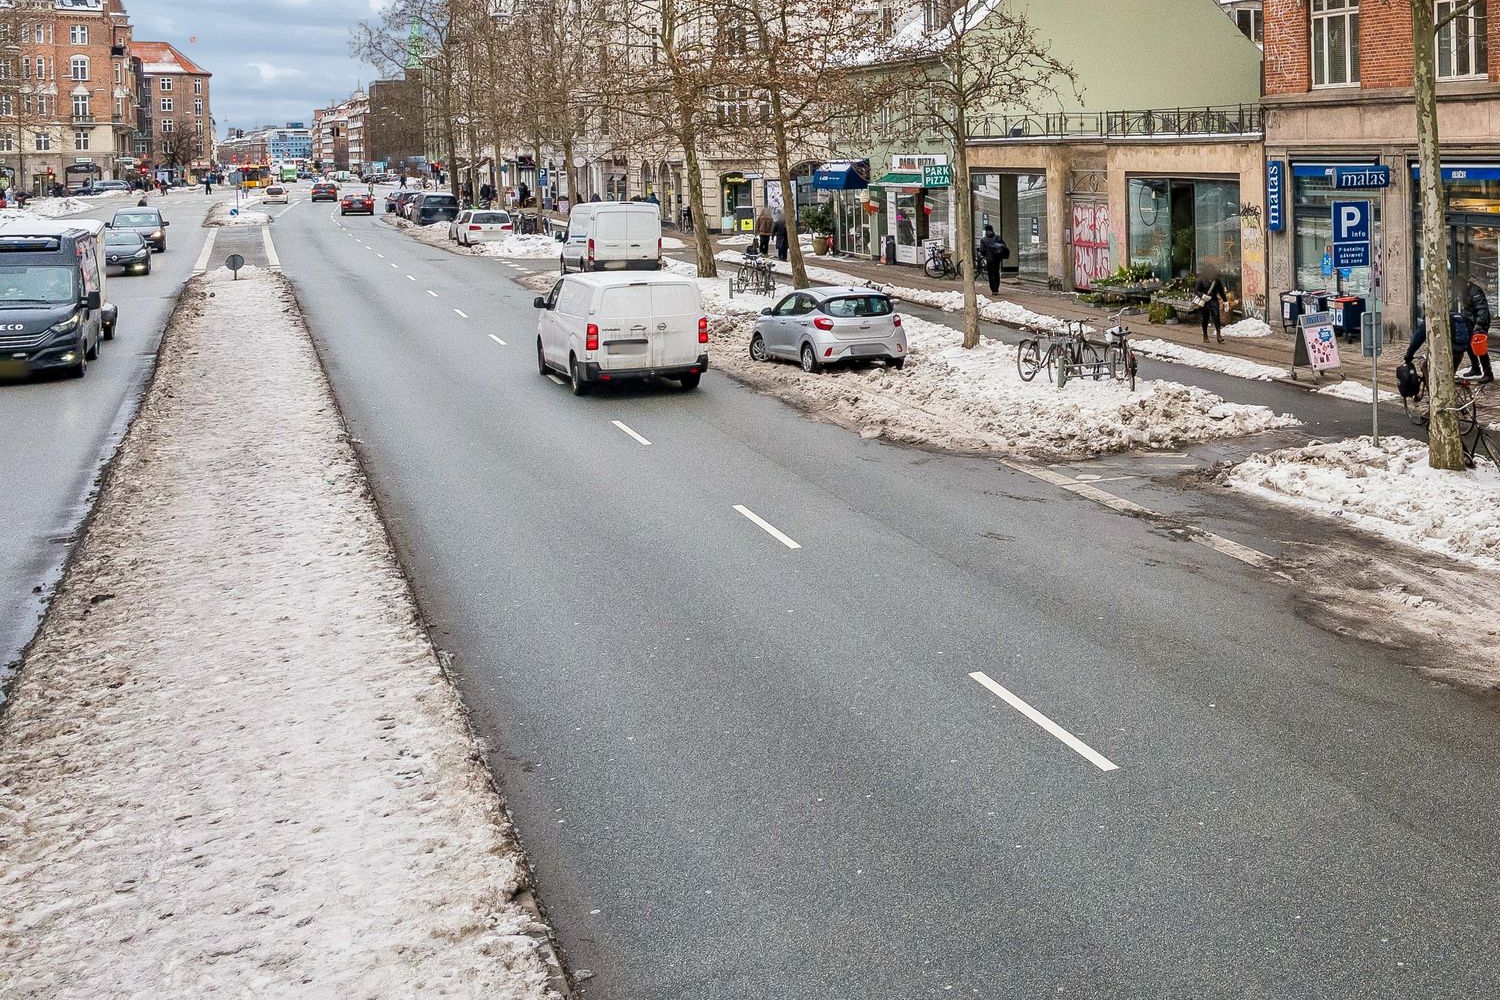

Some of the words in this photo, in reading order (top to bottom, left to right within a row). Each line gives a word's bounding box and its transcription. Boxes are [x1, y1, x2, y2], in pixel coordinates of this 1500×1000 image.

[539, 169, 546, 178] P
[925, 166, 949, 176] PARK
[1341, 169, 1386, 186] matas
[1268, 165, 1279, 225] matas
[1341, 206, 1361, 238] P
